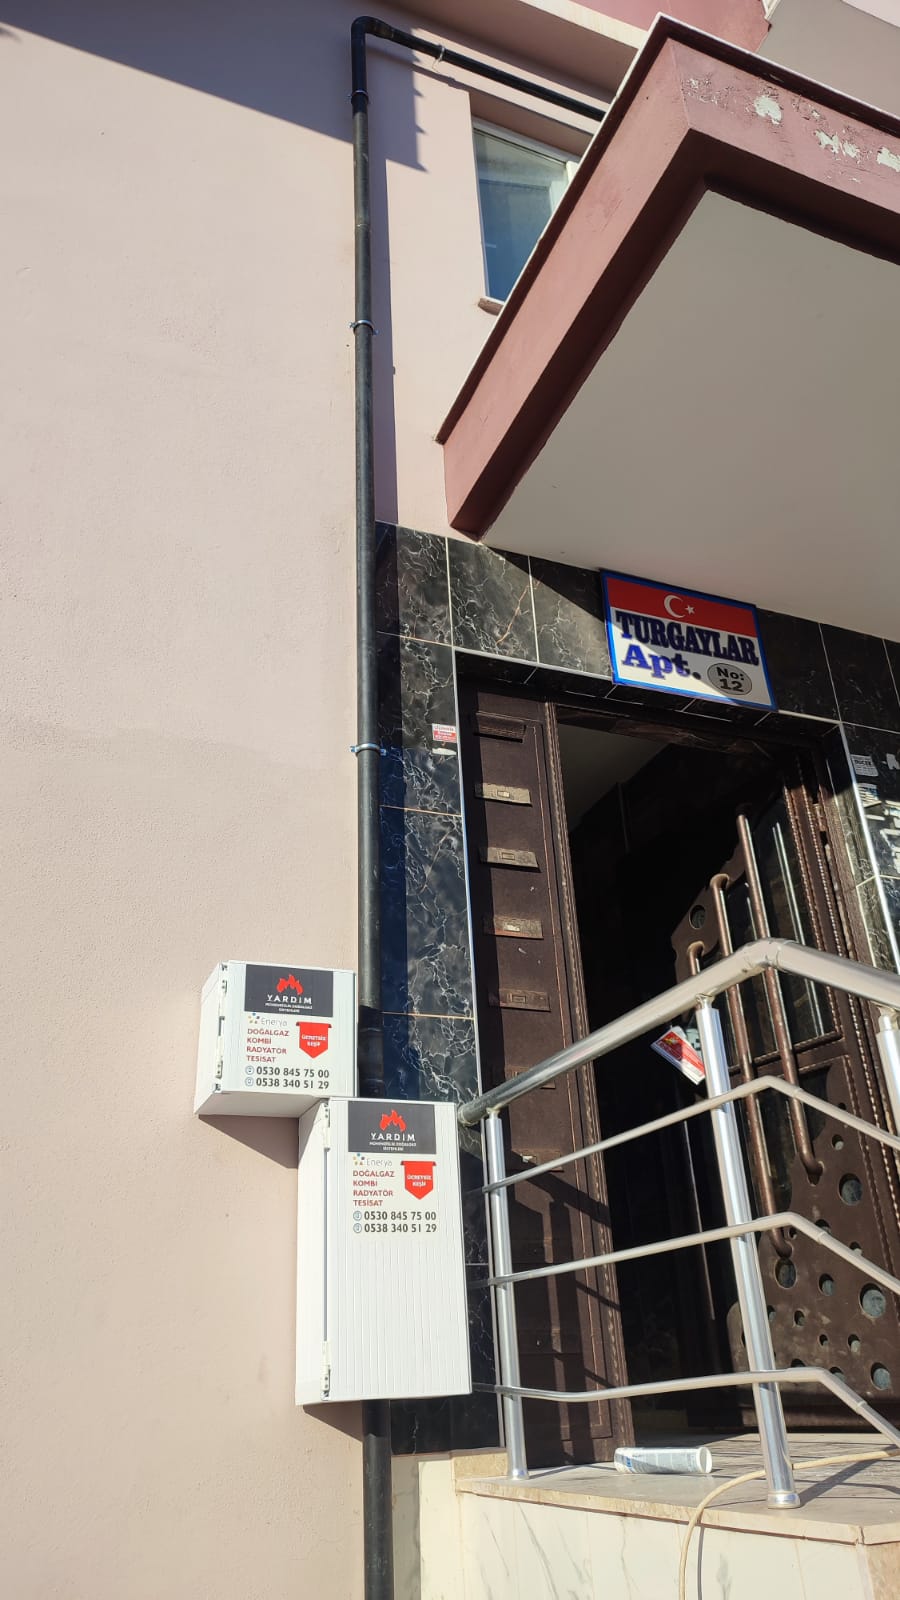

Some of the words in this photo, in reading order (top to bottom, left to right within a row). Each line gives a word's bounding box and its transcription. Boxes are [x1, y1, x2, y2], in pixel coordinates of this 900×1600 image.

[615, 610, 759, 666] TURGAYLAR
[622, 644, 701, 680] Apt.
[717, 666, 745, 681] No:
[719, 678, 744, 692] 12
[267, 995, 312, 1004] YARDIM
[261, 1017, 288, 1028] Enerya
[247, 1028, 289, 1036] DOĞALGAZ
[246, 1036, 272, 1044] KOMBİ
[256, 1066, 281, 1076] 0530
[283, 1067, 301, 1077] 845
[303, 1068, 314, 1077] 75
[317, 1069, 330, 1078] 00
[256, 1078, 280, 1087] 0538
[282, 1078, 301, 1088] 340
[303, 1080, 314, 1089] 51
[317, 1080, 330, 1090] 29
[370, 1132, 415, 1141] YARDIM
[366, 1158, 393, 1168] Enerya
[352, 1169, 396, 1178] DOĞALGAZ
[352, 1179, 378, 1187] KOMBİ
[352, 1188, 394, 1197] RADYATÖR
[352, 1198, 384, 1207] TESİSAT
[364, 1210, 388, 1221] 0530
[390, 1211, 408, 1221] 845
[410, 1211, 422, 1221] 75
[424, 1211, 437, 1221] 00
[364, 1223, 388, 1233] 0538
[391, 1223, 409, 1233] 340
[411, 1223, 422, 1233] 51
[425, 1223, 437, 1233] 29
